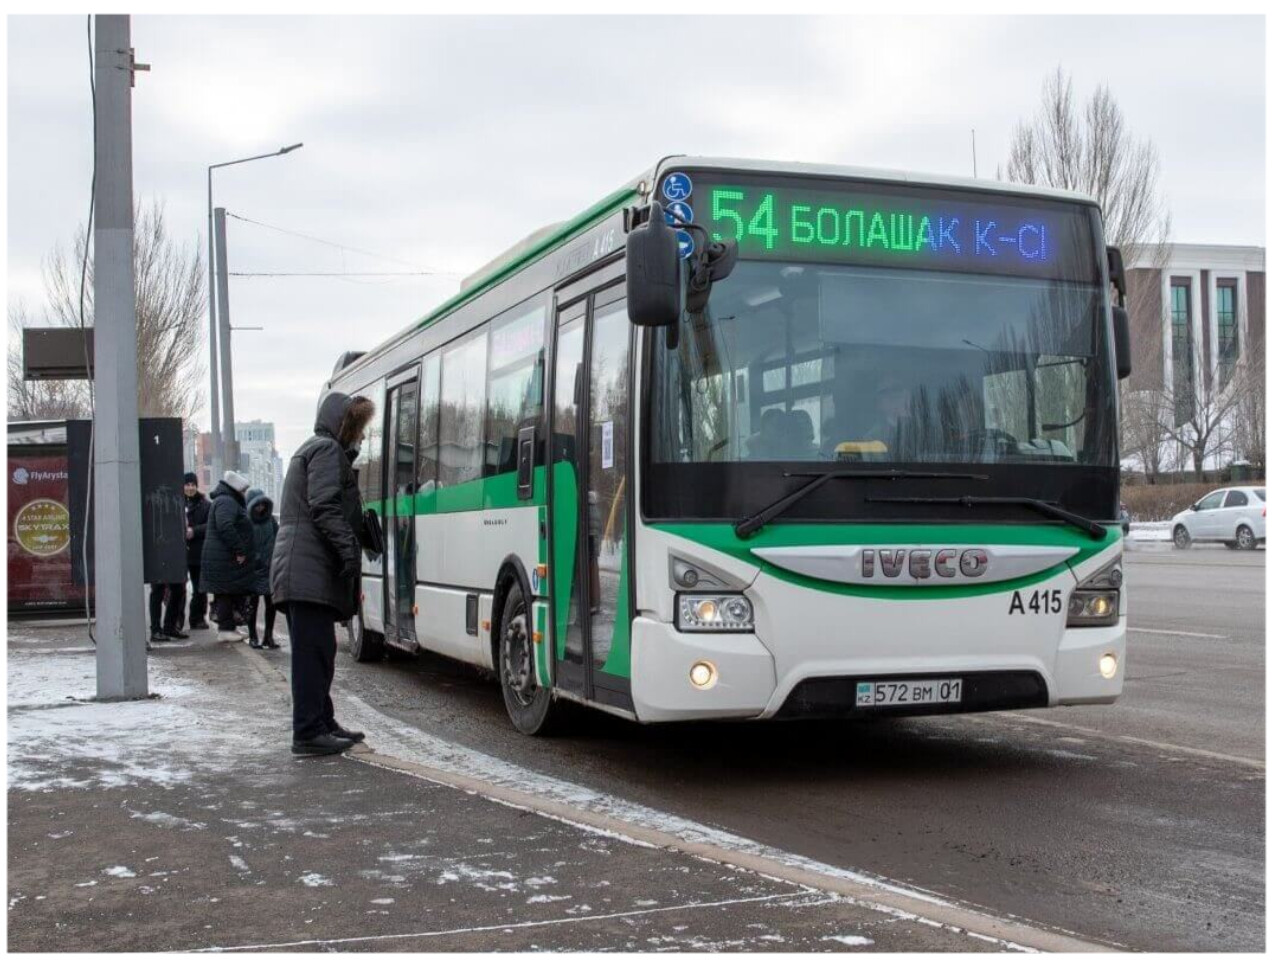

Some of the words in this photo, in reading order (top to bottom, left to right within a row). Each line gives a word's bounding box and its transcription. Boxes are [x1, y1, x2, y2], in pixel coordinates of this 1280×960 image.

[713, 190, 779, 249] 54
[792, 205, 961, 254] БОЛАШАК
[861, 548, 988, 579] IVECO
[1008, 590, 1026, 615] A
[1028, 589, 1062, 614] 415
[875, 683, 909, 703] 572
[912, 687, 933, 701] BM
[940, 682, 960, 700] 01
